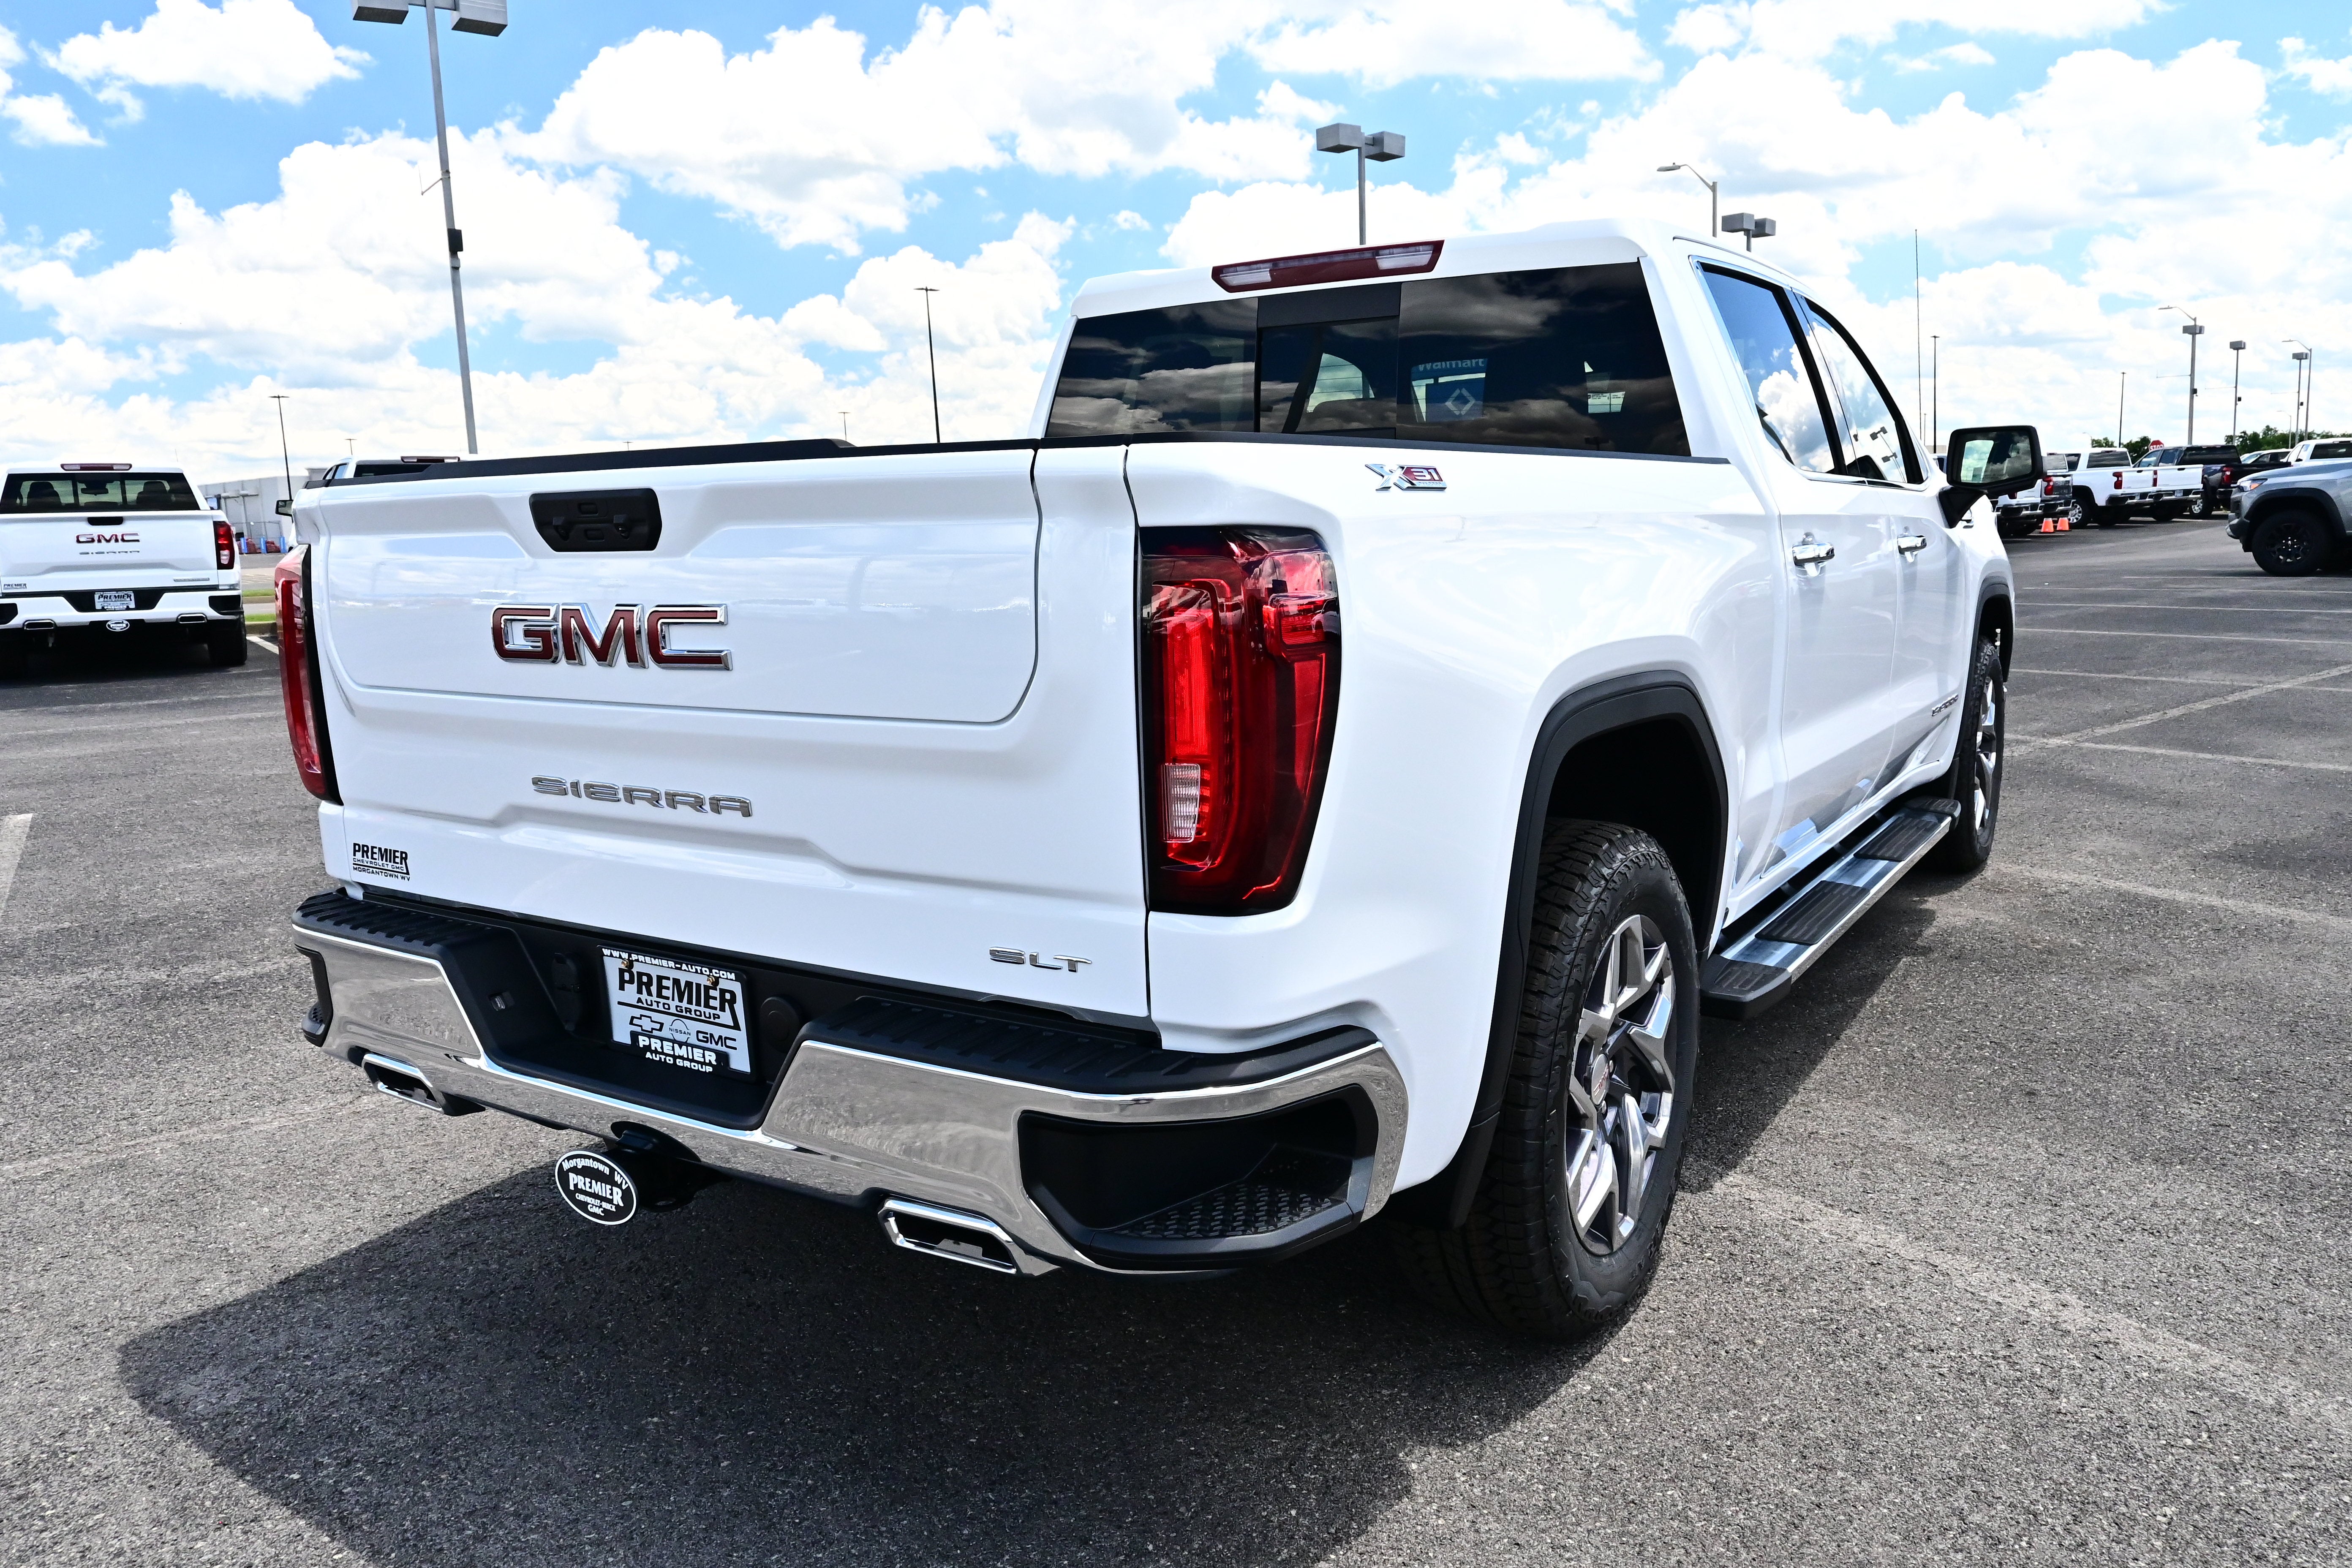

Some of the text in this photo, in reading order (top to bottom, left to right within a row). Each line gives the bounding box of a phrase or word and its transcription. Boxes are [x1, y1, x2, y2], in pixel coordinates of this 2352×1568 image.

[1365, 464, 1446, 490] X31
[76, 532, 140, 543] GMC
[490, 602, 734, 670] GMC
[531, 774, 753, 818] SIERRA
[353, 842, 409, 871] PREMIER
[353, 858, 389, 868] CHEVROLET
[353, 866, 399, 879] MORGANTOWN
[602, 948, 736, 980] WWW.PREMIER-AUTO.COM
[989, 946, 1093, 973] SLT
[618, 967, 740, 1021] PREMIER
[636, 997, 721, 1020] AUTO GROUP
[669, 1027, 691, 1036] NISSAN
[696, 1030, 738, 1050] GMC
[638, 1035, 717, 1065] PREMIER
[645, 1052, 713, 1073] AUTO GROUP
[562, 1158, 629, 1190] Morgantown WV
[569, 1172, 624, 1207] PREMIER
[588, 1204, 604, 1216] GMC
